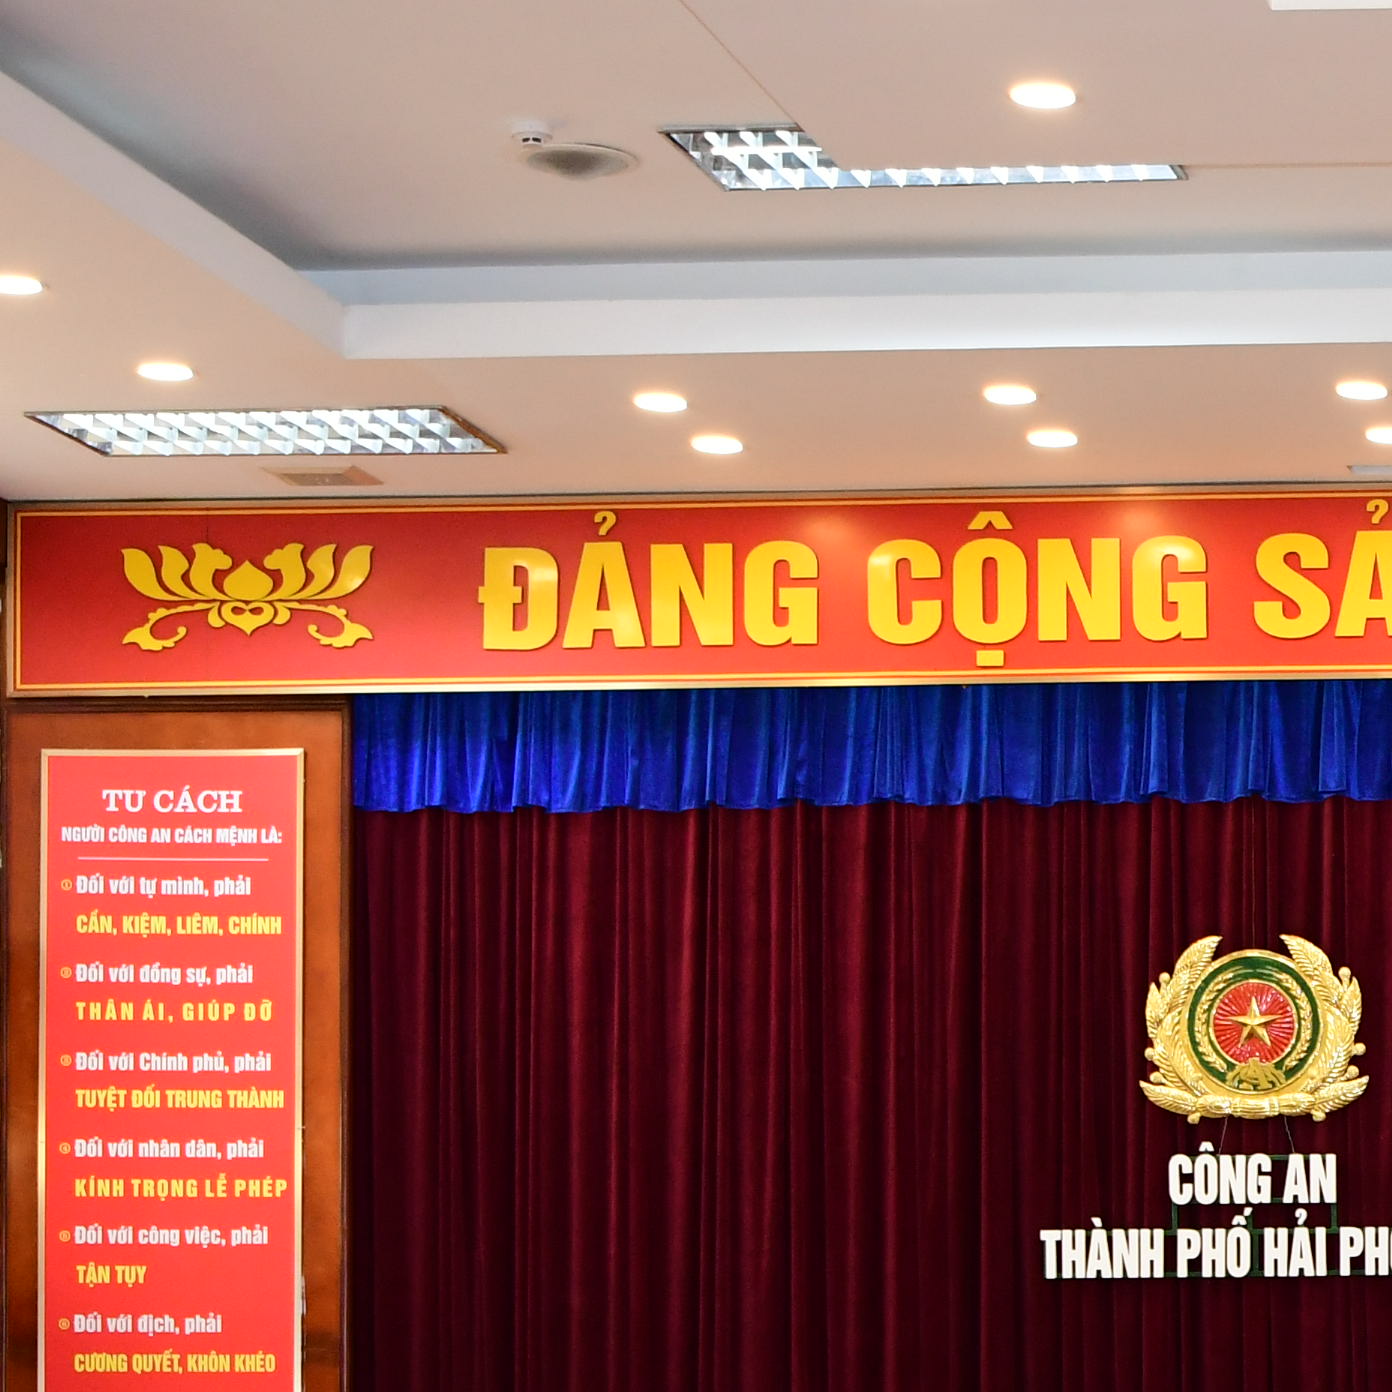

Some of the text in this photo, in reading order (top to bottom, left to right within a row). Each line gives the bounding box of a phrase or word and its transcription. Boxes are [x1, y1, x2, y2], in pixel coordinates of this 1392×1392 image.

[479, 510, 818, 650] ĐẢNG
[866, 511, 1207, 667] CỘNG
[102, 785, 243, 813] TƯ CÁCH
[62, 824, 282, 846] NGƯỜI CÔNG AN CÁCH MỆNH LÀ:
[76, 873, 251, 898] Đối với tự mình, phải
[123, 912, 171, 938] KIỆM,
[177, 912, 223, 936] LIÊM,
[228, 913, 282, 934] CHÍNH
[76, 999, 272, 1023] THÂN ÁI, GIÚP ĐỠ
[76, 1084, 284, 1112] TUYỆT ĐỐI TRUNG THÀNH
[1168, 1141, 1337, 1205] CÔNG AN
[75, 1173, 287, 1201] KÍNH TRỌNG LỄ PHÉP
[1040, 1217, 1164, 1279] THÀNH
[1177, 1207, 1253, 1278] PHỐ
[1264, 1208, 1327, 1277] HẢI
[76, 1262, 147, 1287] TẬN TỤY
[74, 1349, 275, 1374] CƯƠNG QUYẾT, KHÔN KHÉO
